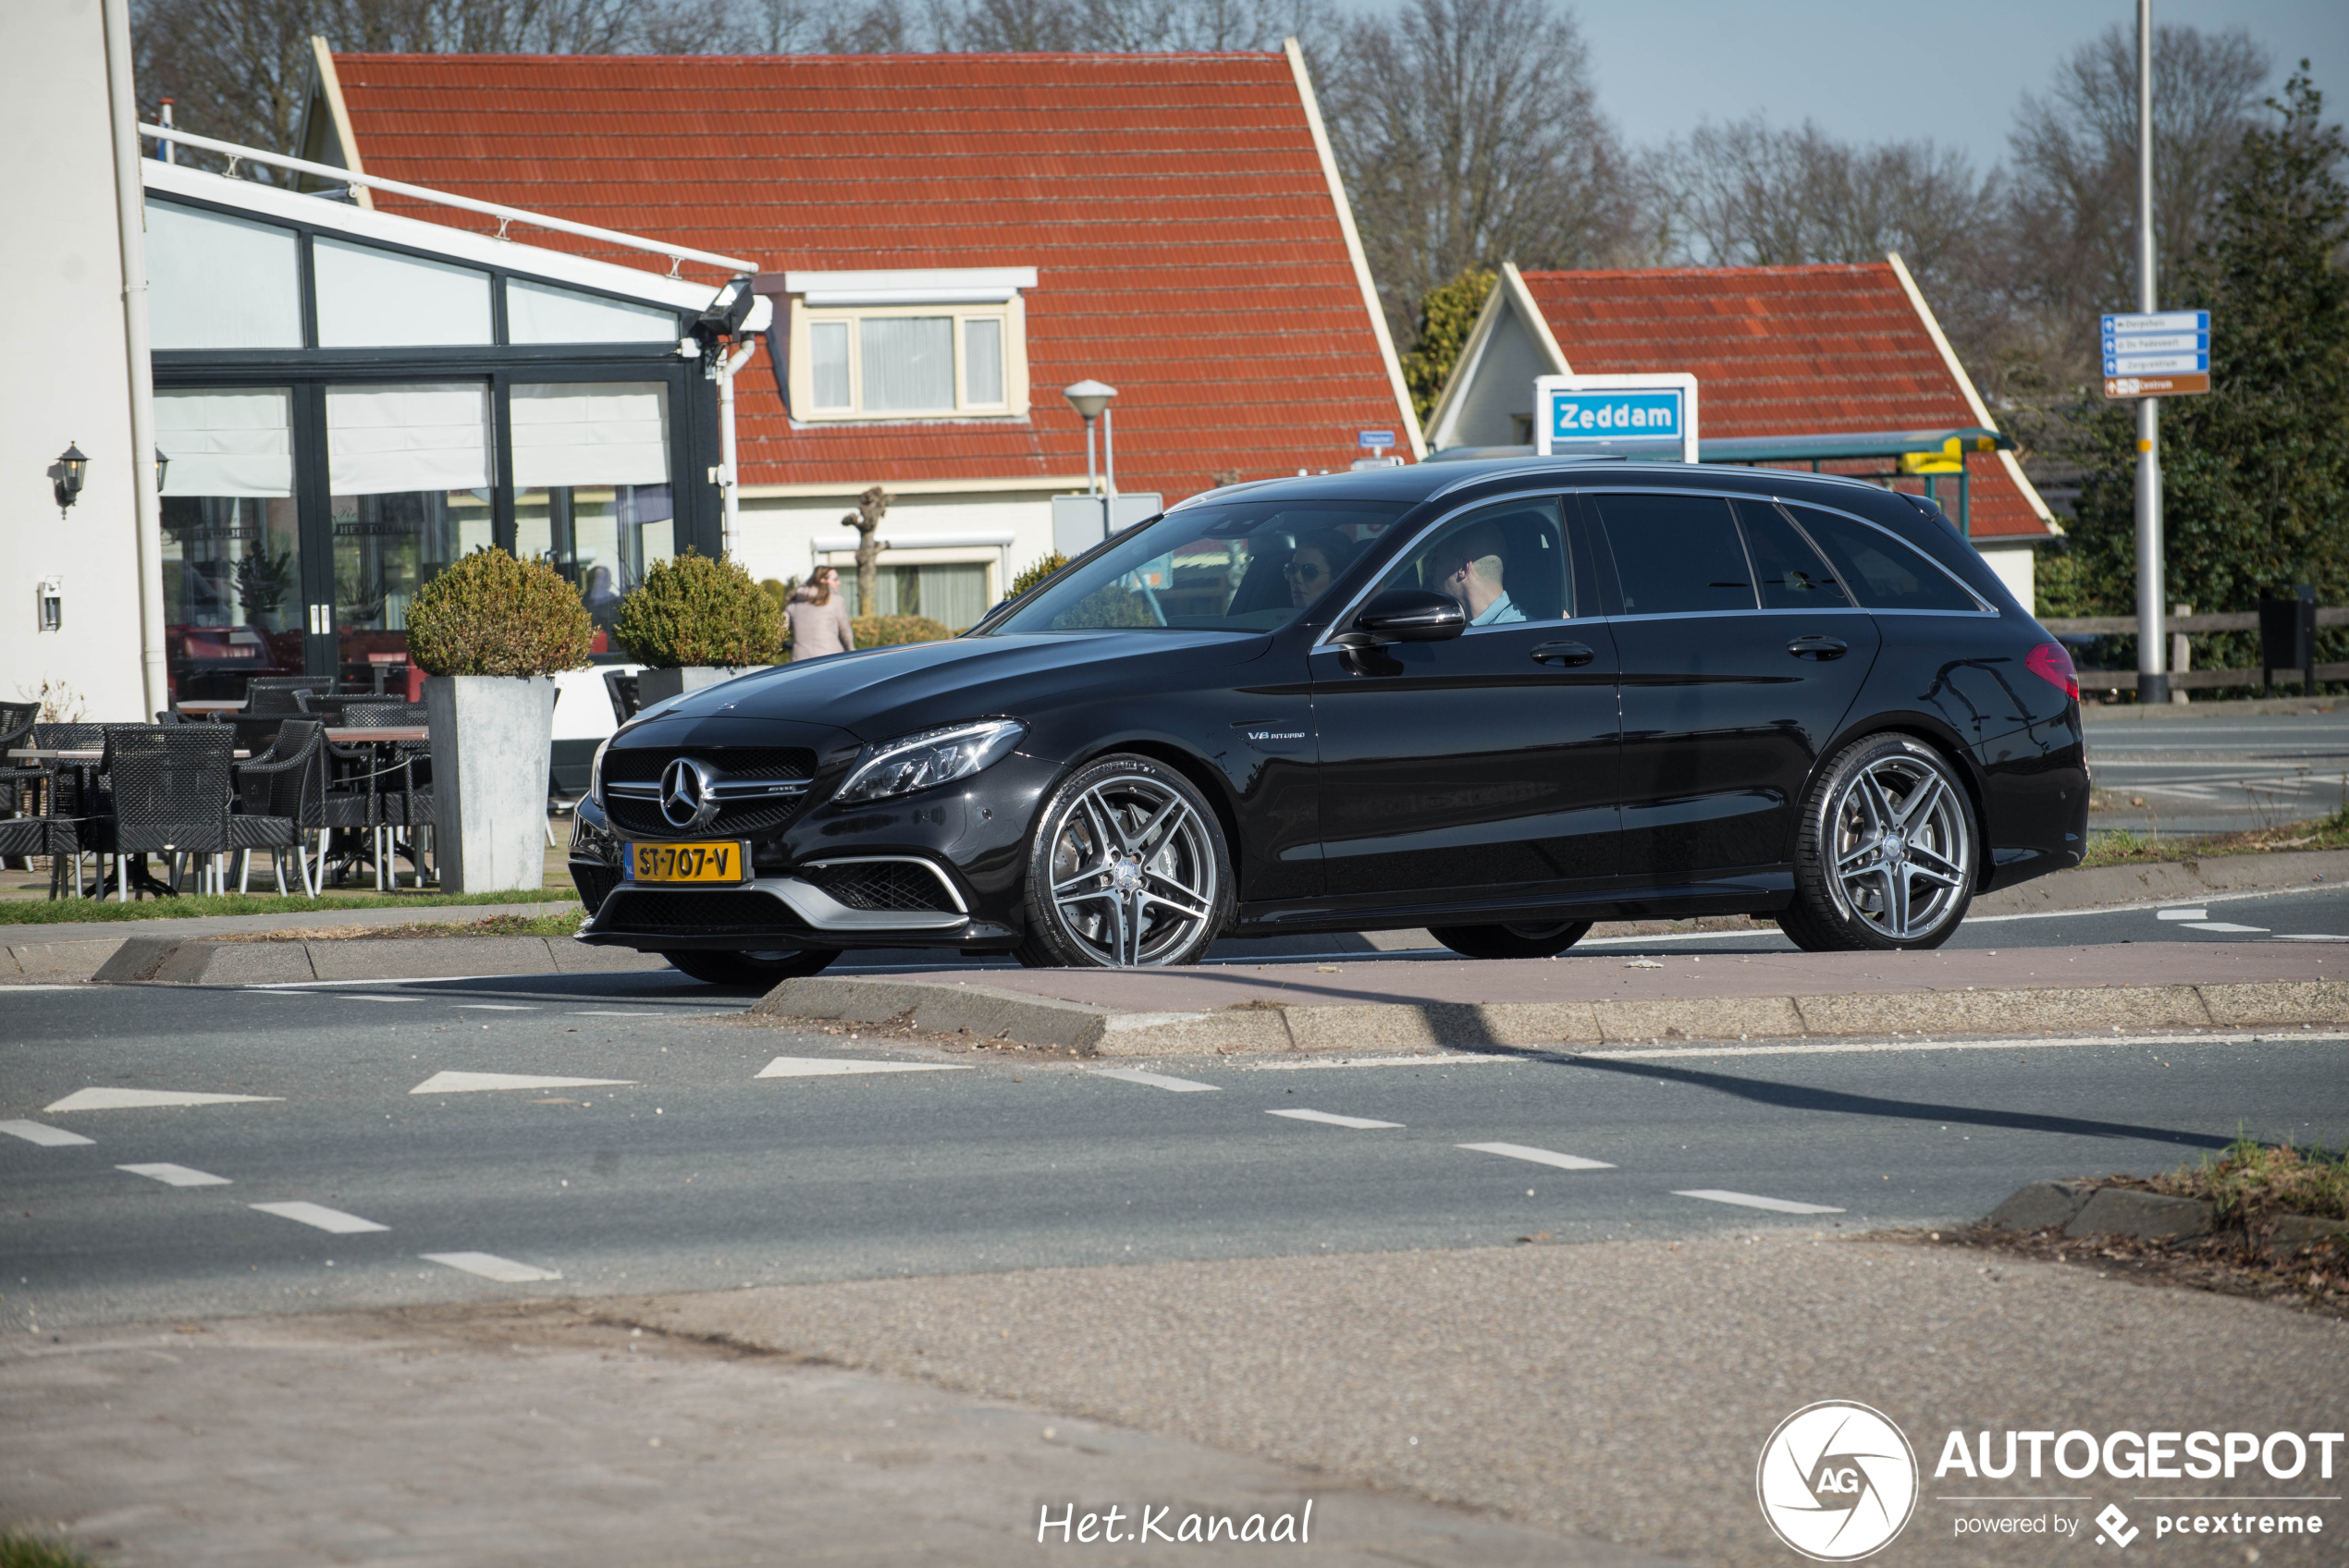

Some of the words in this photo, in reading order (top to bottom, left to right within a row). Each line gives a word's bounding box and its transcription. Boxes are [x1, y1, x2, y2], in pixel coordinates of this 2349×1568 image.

[2139, 379, 2173, 390] Centrum
[1559, 403, 1672, 429] Zeddam
[1248, 731, 1270, 740] V8
[639, 847, 729, 876] ST-707-V
